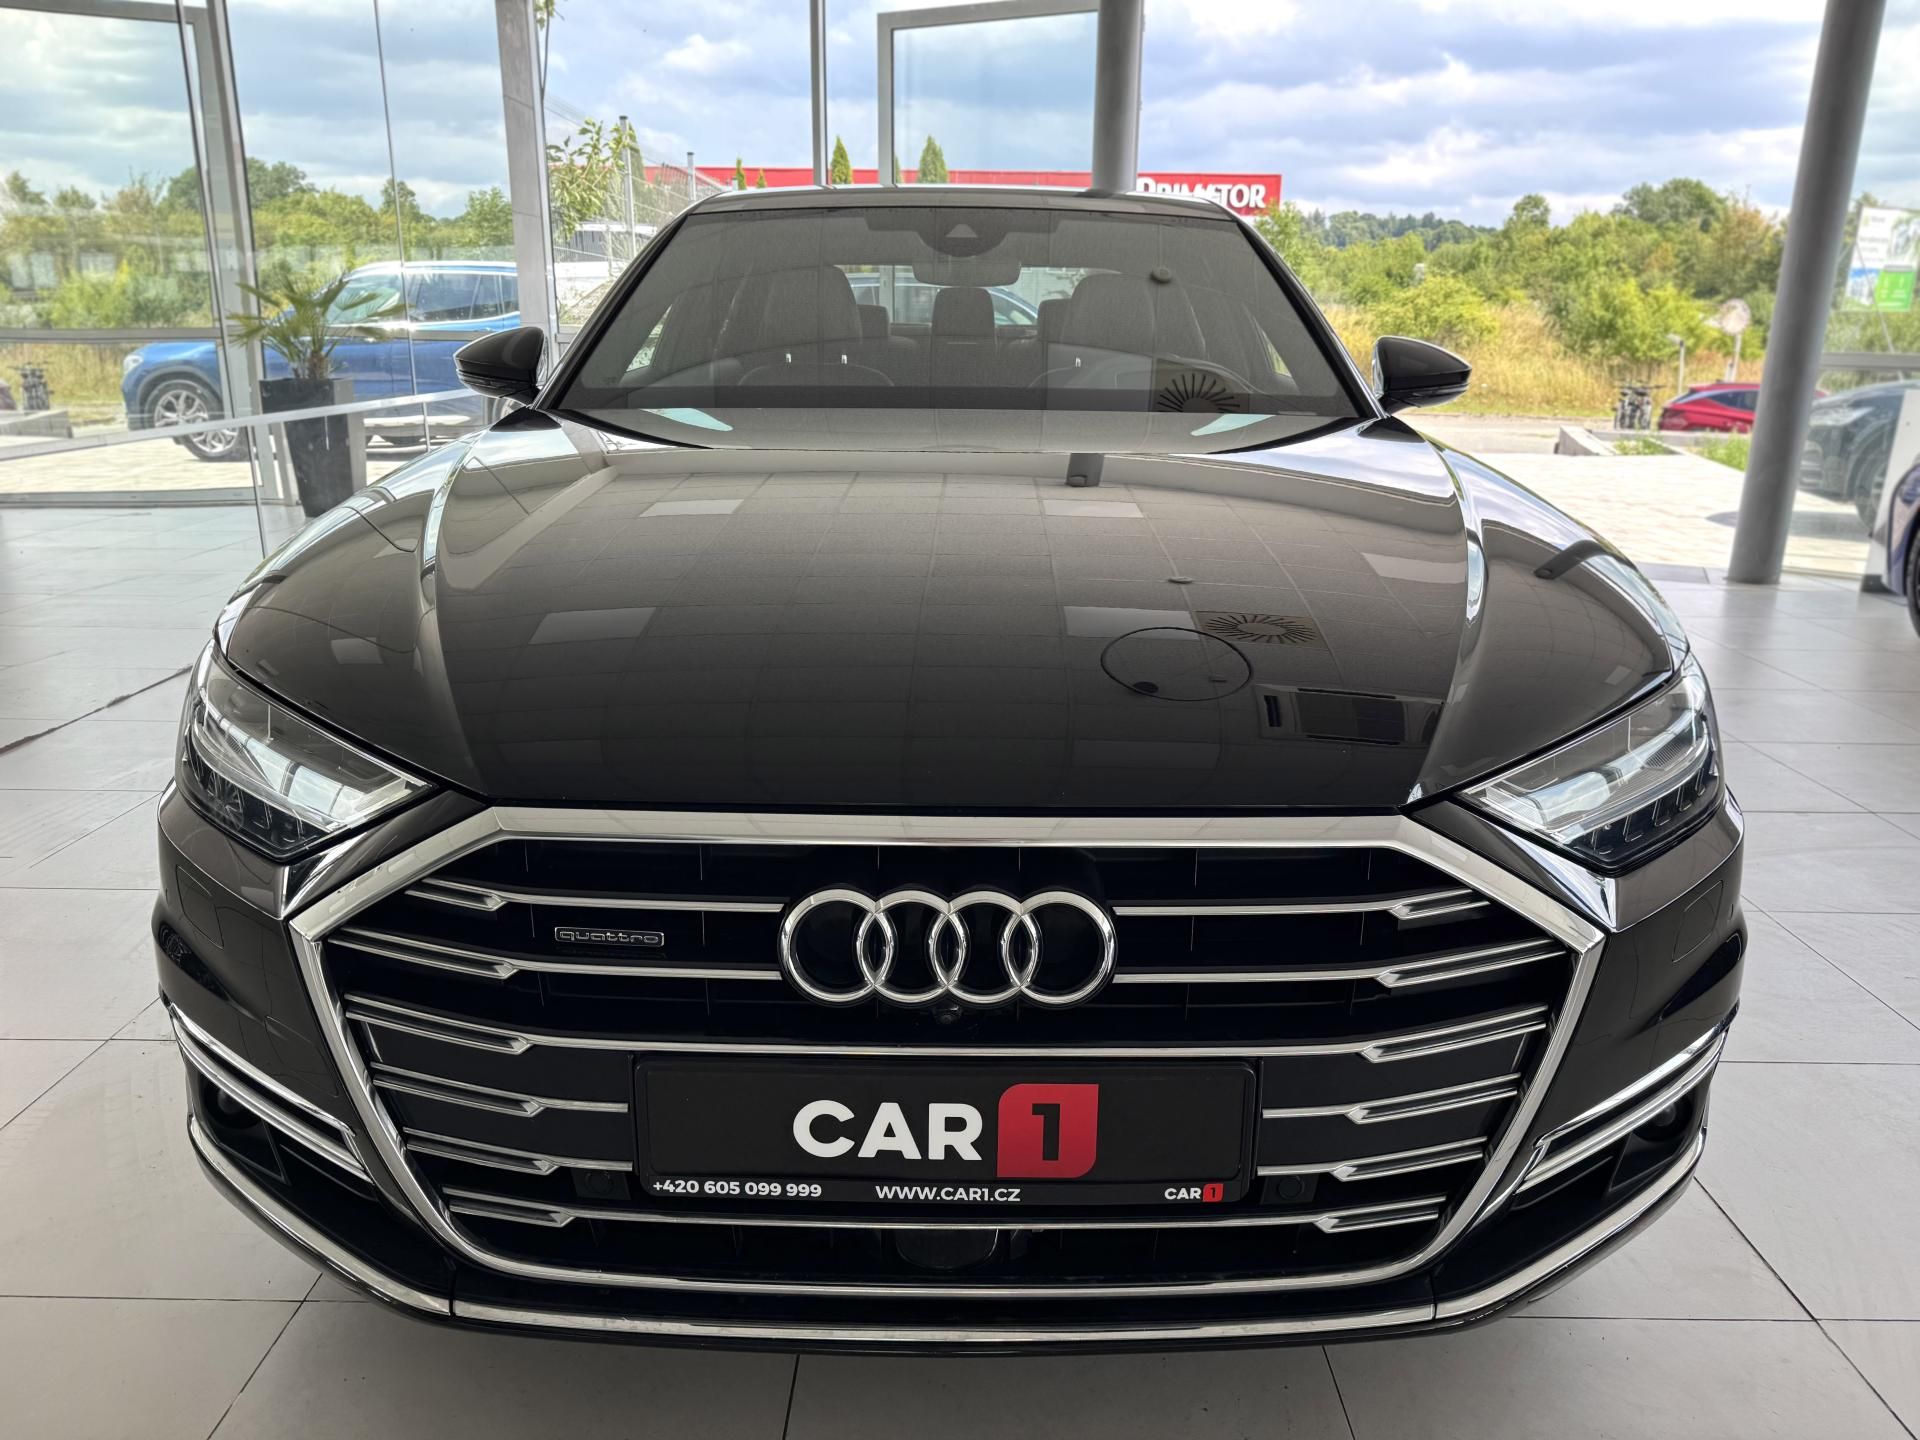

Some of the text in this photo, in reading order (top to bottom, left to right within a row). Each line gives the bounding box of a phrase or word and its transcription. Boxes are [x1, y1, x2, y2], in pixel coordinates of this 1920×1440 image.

[559, 931, 659, 944] quattro
[652, 1179, 822, 1198] +420 605 099 999
[875, 1185, 1021, 1202] WWW.CAR1.CZ
